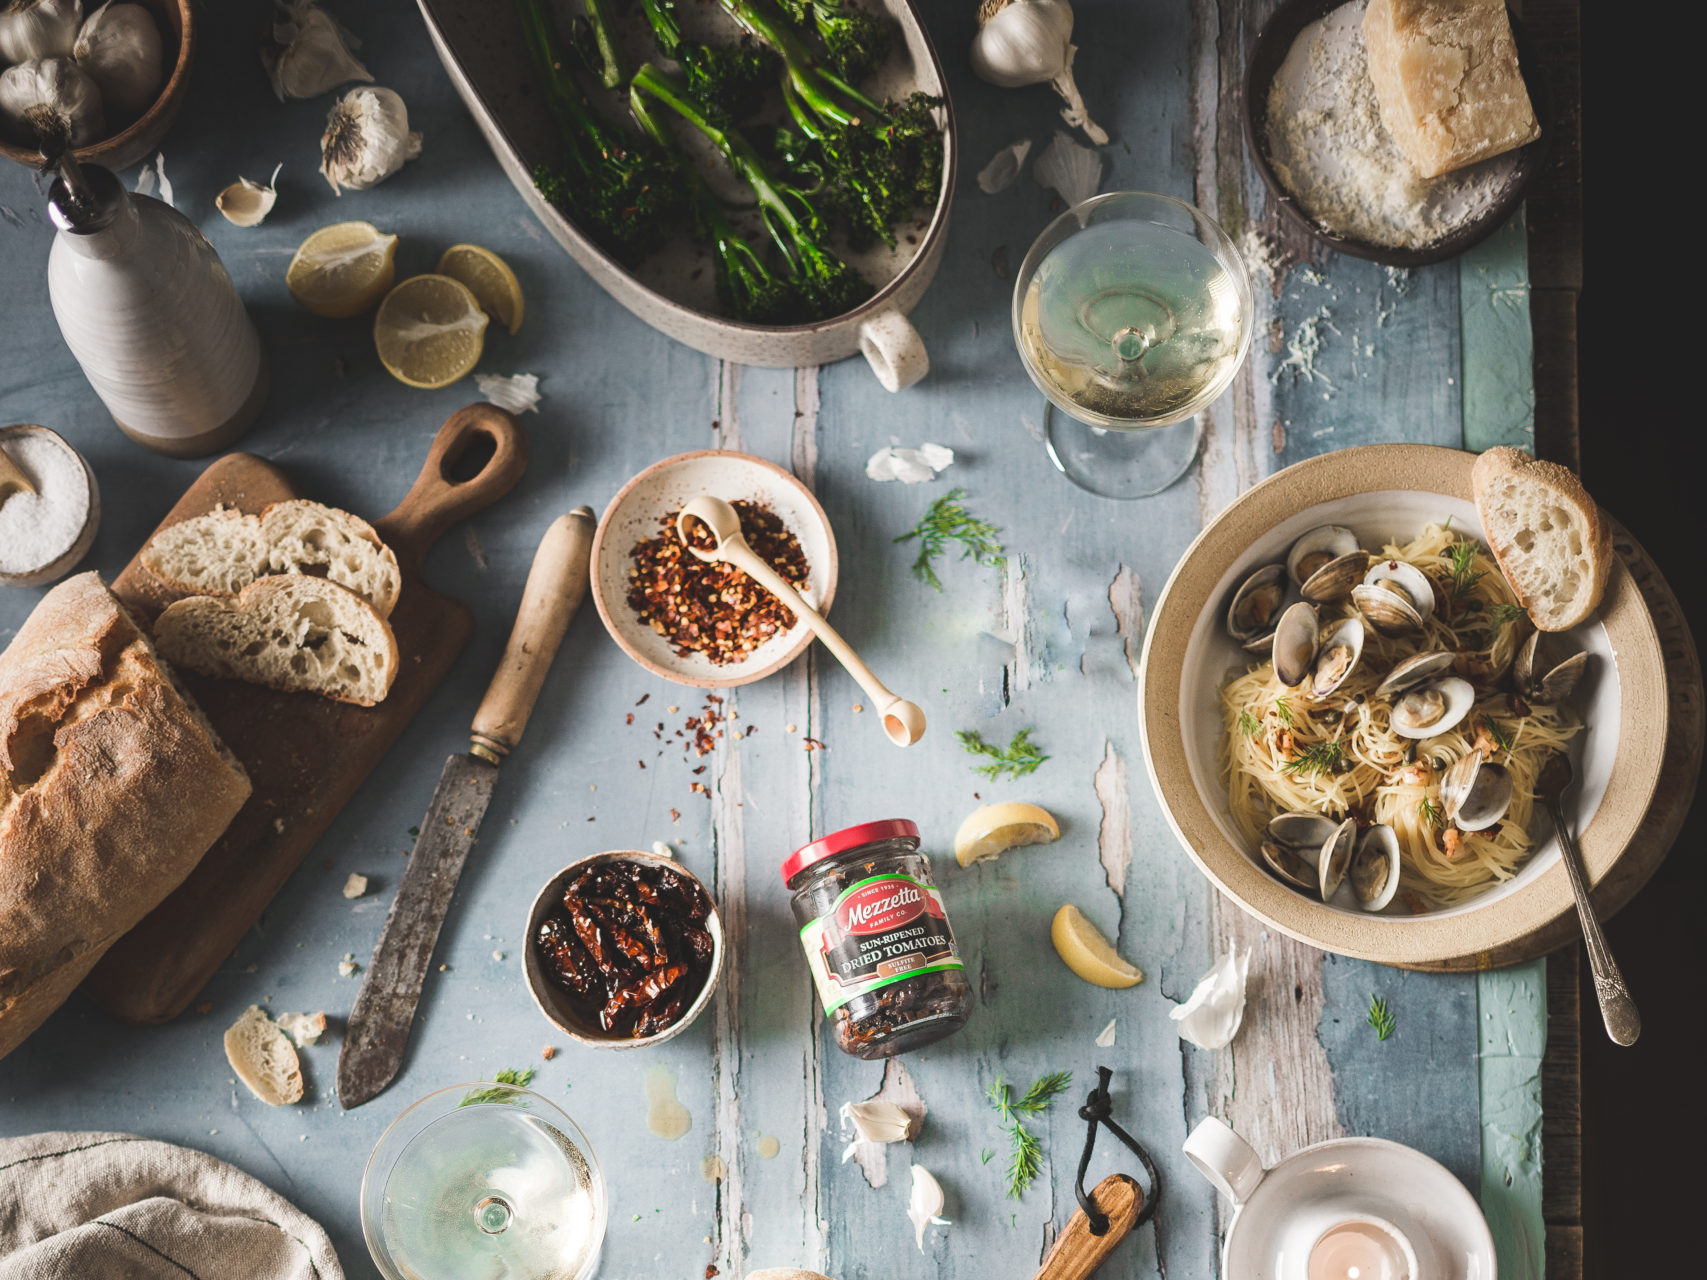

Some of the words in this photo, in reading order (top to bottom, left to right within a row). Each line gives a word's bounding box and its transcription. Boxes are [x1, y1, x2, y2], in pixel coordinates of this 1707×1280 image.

[861, 887, 879, 898] SINCE
[844, 887, 921, 932] Mezzetta
[869, 914, 894, 929] FAMILY
[860, 927, 925, 952] SUN-RIPENED
[841, 950, 882, 974] DRIED
[883, 935, 947, 958] TOMATOES
[888, 957, 915, 969] SULFITE
[894, 964, 912, 973] FREE
